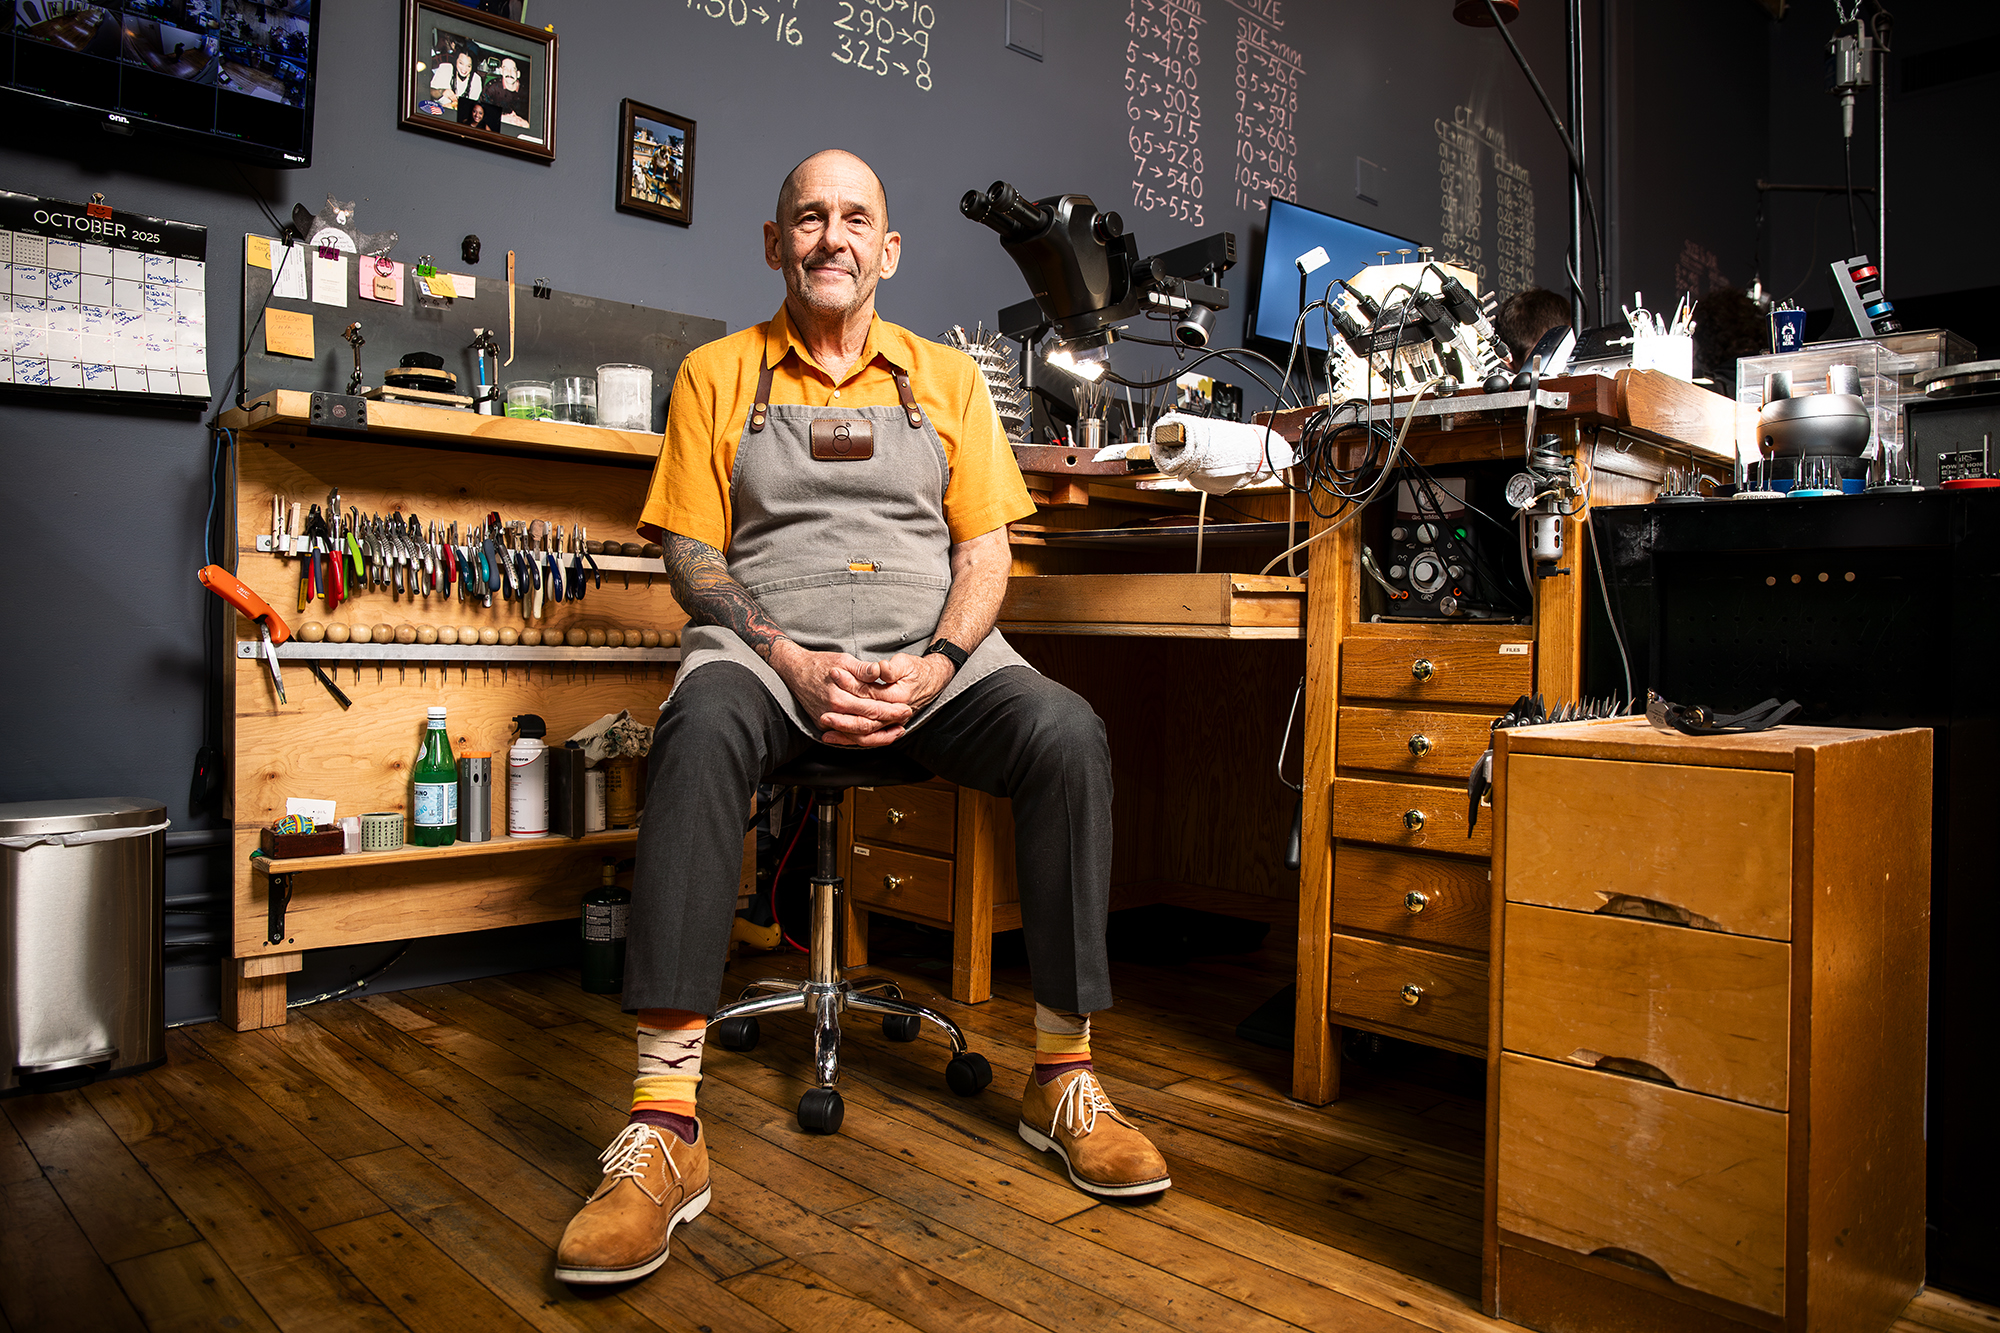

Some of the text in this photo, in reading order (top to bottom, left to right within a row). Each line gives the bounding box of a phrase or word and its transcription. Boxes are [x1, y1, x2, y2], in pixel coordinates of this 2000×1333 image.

[775, 13, 803, 46] 16
[833, 1, 929, 59] 2.90 9
[912, 0, 935, 29] 10
[1158, 3, 1202, 40] 46.5
[1125, 11, 1201, 66] 4.5 47.8
[1237, 17, 1302, 68] SIZE mm
[831, 34, 932, 91] 3.25 8
[1126, 40, 1197, 91] 5 49.0
[1235, 40, 1298, 90] 8 56.6
[1125, 67, 1201, 119] 5.5 50.3
[1235, 64, 1298, 113] 8.5 57.8
[1235, 90, 1293, 131] 9 59.1
[108, 113, 130, 124] onn.
[1127, 96, 1201, 144] 6 51.5
[1235, 112, 1297, 157] 9.5 60.3
[1128, 126, 1204, 174] 6.5 52.8
[1236, 139, 1297, 182] 10 61.6
[1134, 154, 1203, 198] 7 54.0
[1235, 163, 1297, 204] 10.5 62.8
[1132, 180, 1204, 227] 7.5 55.3
[1235, 188, 1247, 211] 11
[16, 234, 44, 242] NOVEMBER
[33, 209, 161, 244] OCTOBER 2025
